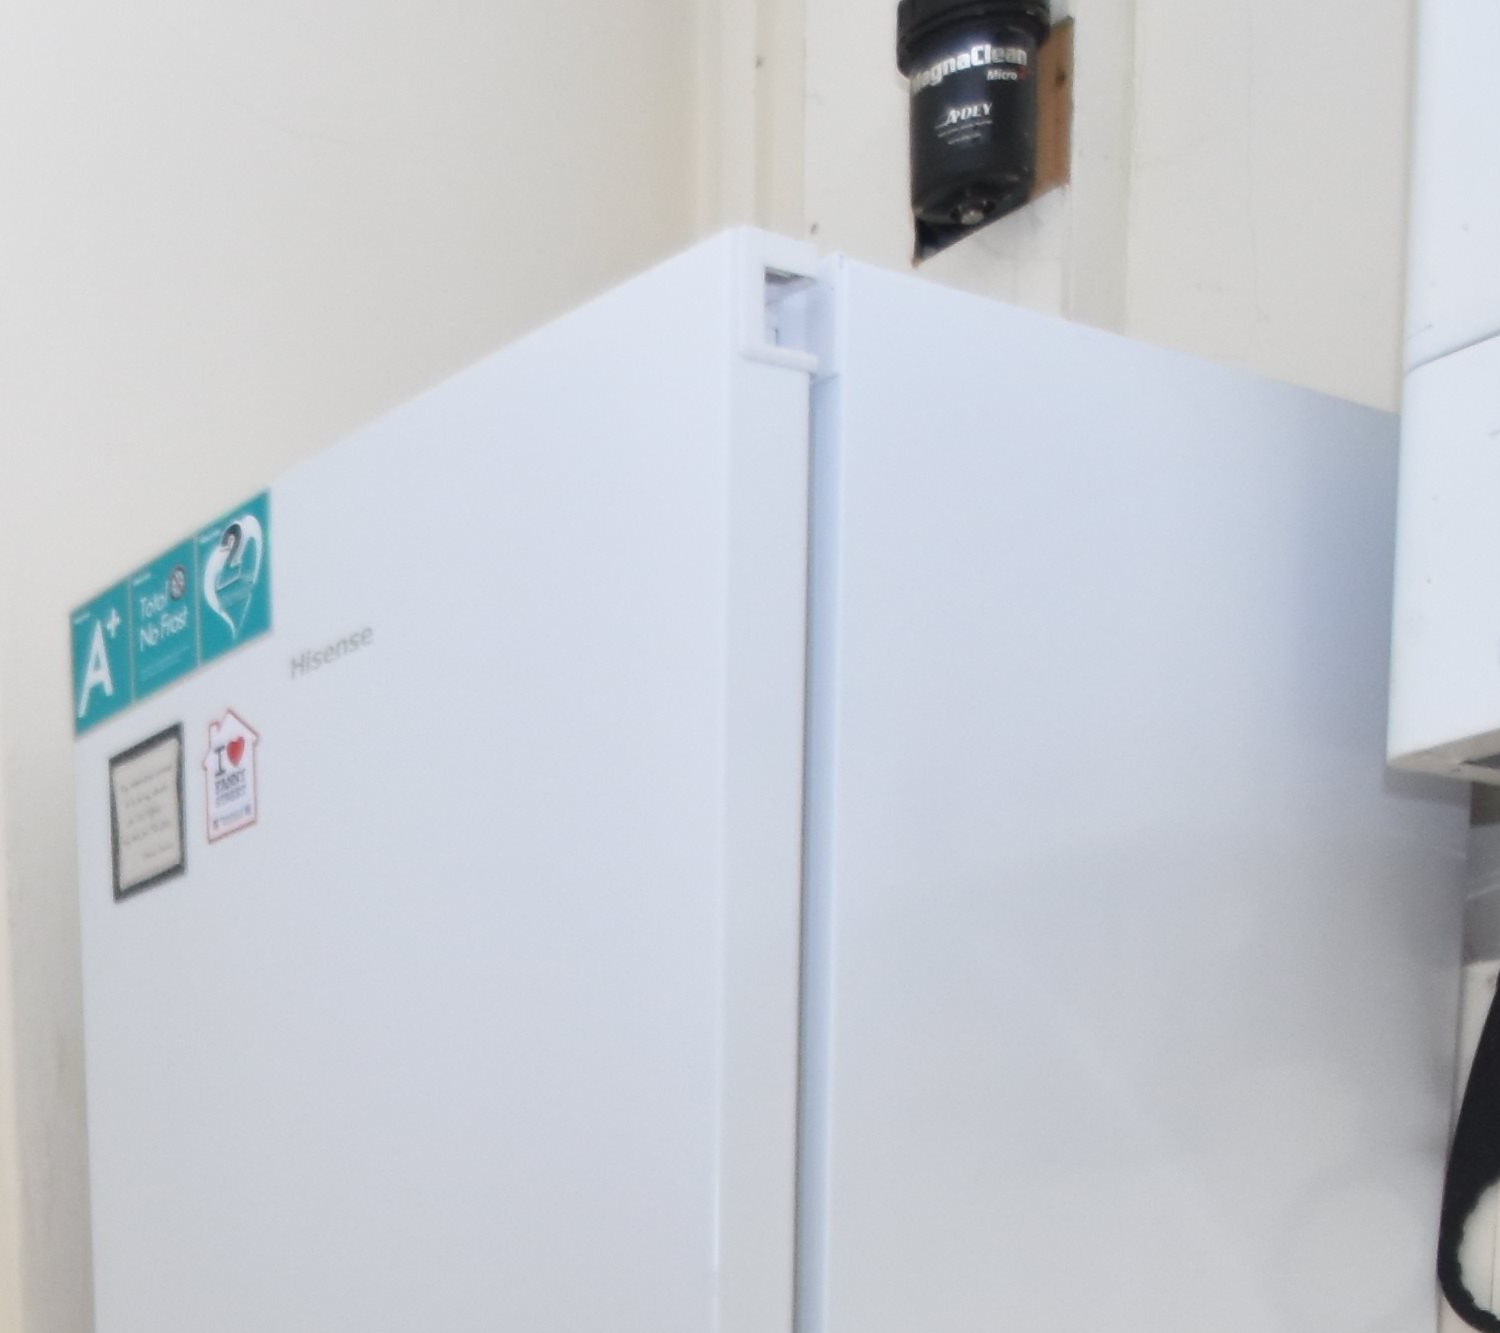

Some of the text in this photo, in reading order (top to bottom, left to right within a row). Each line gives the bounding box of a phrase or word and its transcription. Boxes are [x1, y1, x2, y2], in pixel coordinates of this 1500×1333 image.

[987, 70, 1017, 80] Micro
[140, 623, 160, 652] No
[290, 626, 374, 680] Hisense
[77, 607, 121, 718] A+
[214, 745, 226, 776] I
